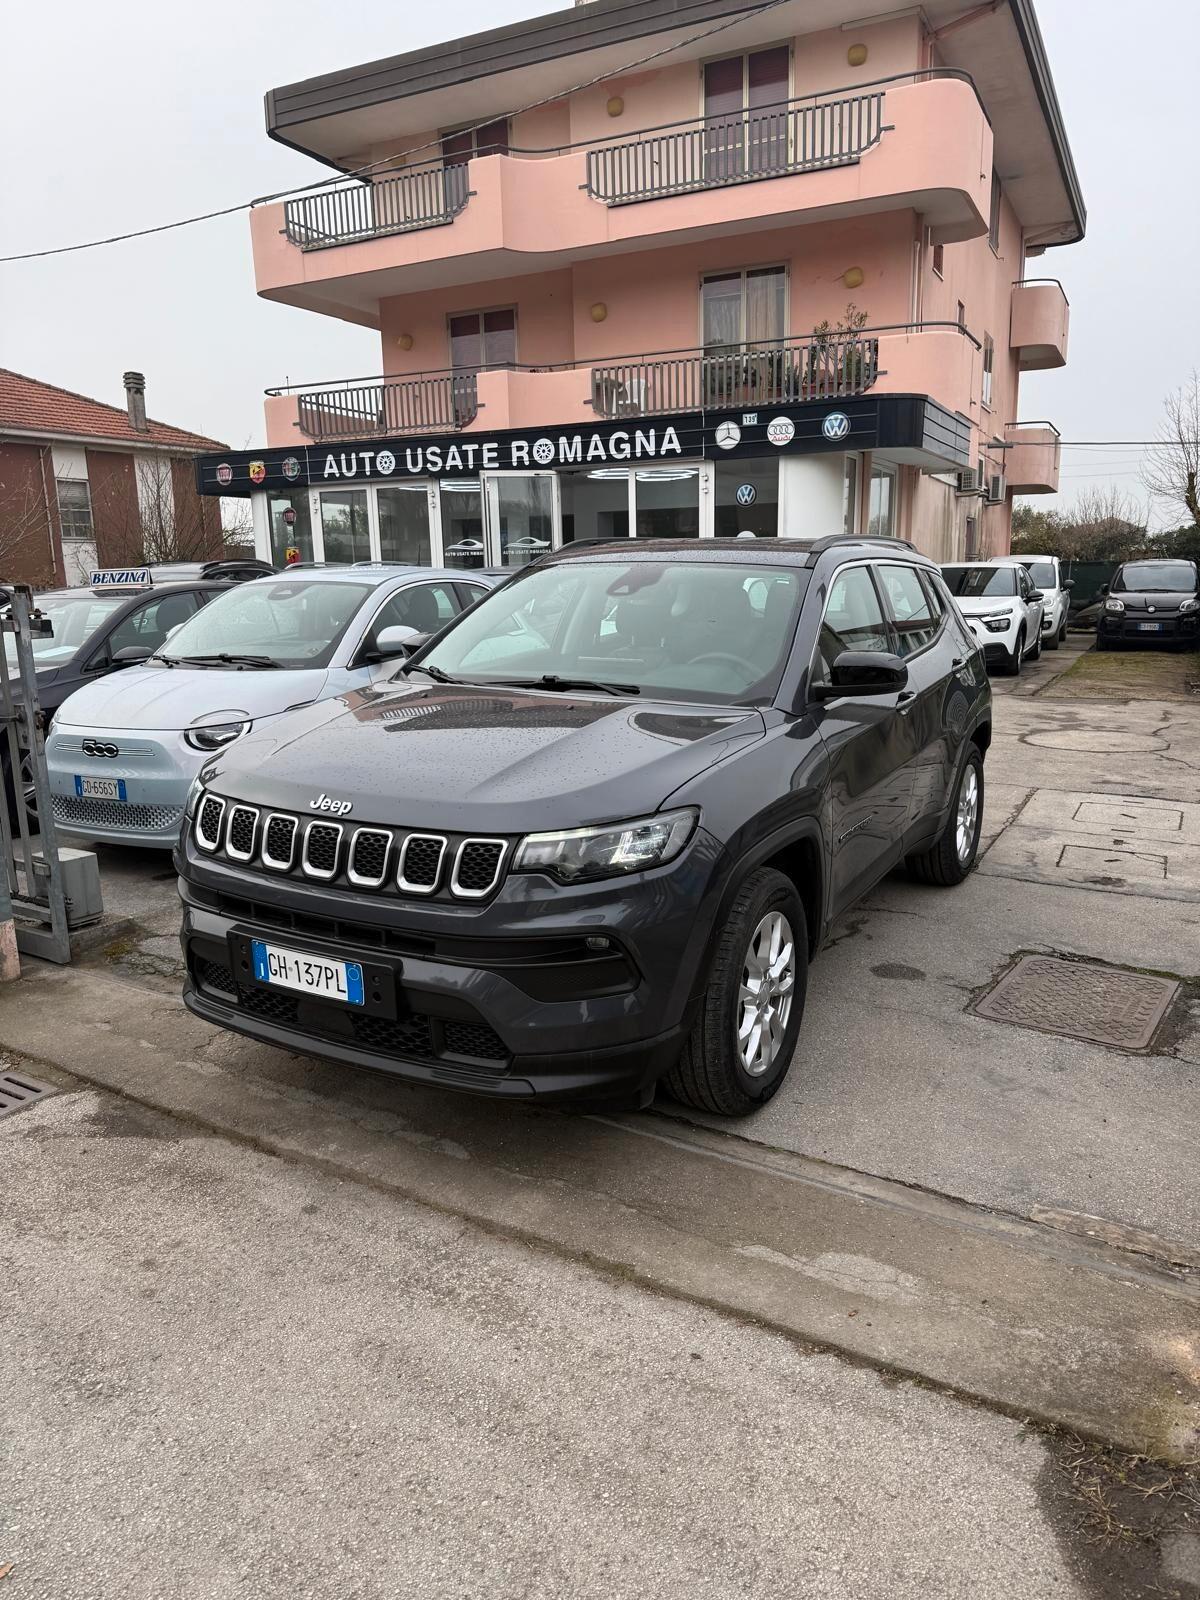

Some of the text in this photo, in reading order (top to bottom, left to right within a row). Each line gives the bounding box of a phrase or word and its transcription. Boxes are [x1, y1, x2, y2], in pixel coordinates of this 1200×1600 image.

[323, 426, 682, 478] AUTO USATE ROMAGNA
[92, 571, 146, 584] BENZINA
[83, 739, 118, 757] 500
[310, 793, 353, 816] Jeep
